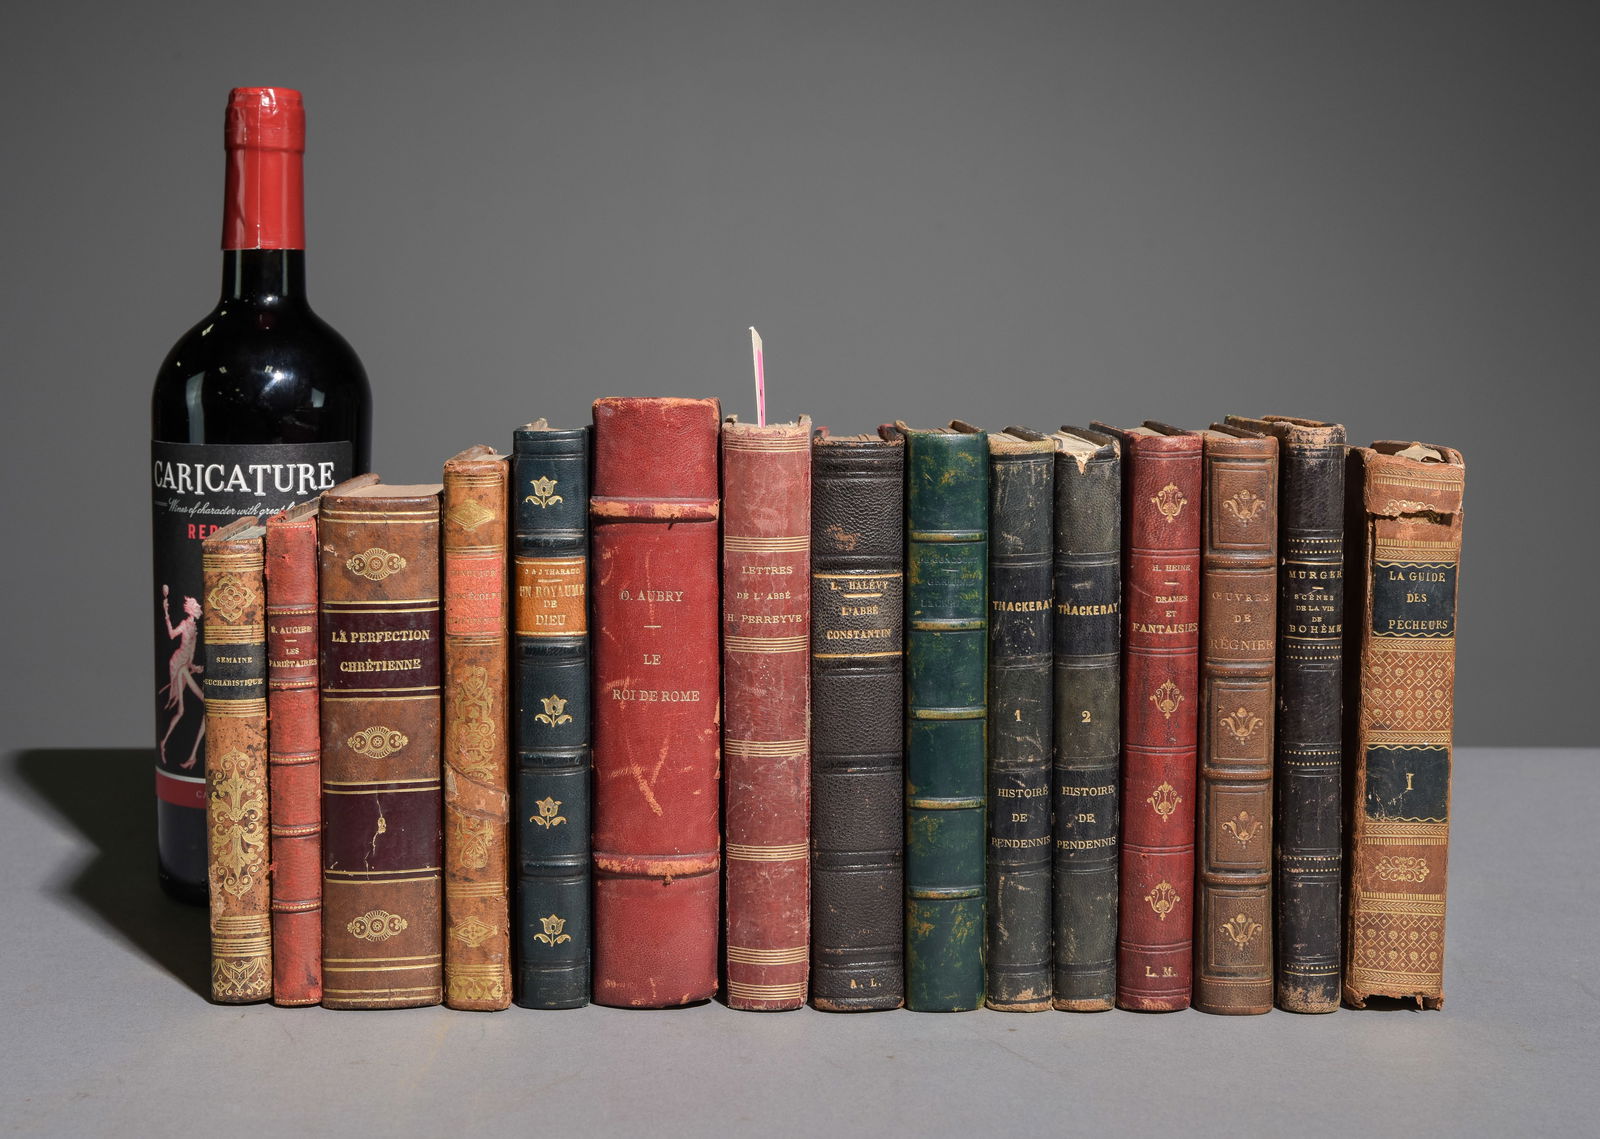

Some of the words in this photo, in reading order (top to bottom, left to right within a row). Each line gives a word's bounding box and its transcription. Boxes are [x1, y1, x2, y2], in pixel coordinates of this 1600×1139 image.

[154, 460, 335, 496] CARICATURE
[197, 501, 236, 515] character
[236, 502, 259, 516] with
[742, 566, 793, 575] LETTRES
[1152, 564, 1163, 572] H.
[1165, 564, 1191, 572] HEINE
[1289, 570, 1342, 579] MURGER
[1389, 571, 1405, 581] LA
[1409, 572, 1446, 582] GUIDE
[830, 581, 842, 591] L.
[848, 580, 888, 590] HALÉVY
[620, 590, 633, 601] O.
[637, 591, 684, 602] AUBRY
[737, 591, 750, 600] DE
[1155, 595, 1188, 603] DRAMES
[1406, 593, 1427, 603] DES
[543, 600, 558, 608] DE
[1057, 602, 1118, 616] THACKERAY
[841, 605, 879, 616] L'ABBÉ
[1165, 610, 1177, 618] ET
[535, 614, 566, 626] DIEU
[727, 613, 738, 622] H.
[741, 614, 803, 624] PERREYVE
[1234, 615, 1251, 623] DE
[279, 625, 312, 635] AUGIER
[1132, 622, 1198, 634] FANTAISIES
[1289, 623, 1342, 634] BOHÈME
[351, 629, 431, 643] PERFECTION
[826, 628, 892, 640] CONSTANTIN
[1209, 637, 1274, 651] RÉGNIER
[286, 647, 300, 655] LES
[215, 656, 253, 664] SEMAINE
[643, 653, 661, 665] LE
[204, 677, 264, 687] EUCHARISTIQUE
[613, 689, 636, 701] ROI
[639, 691, 658, 702] DE
[661, 690, 700, 702] ROME
[1014, 709, 1022, 722] 1
[1081, 710, 1091, 723] 2
[997, 785, 1049, 799] HISTOIRE
[1062, 784, 1117, 797] HISTOIRE
[1012, 813, 1028, 823] DE
[1078, 813, 1096, 823] DE
[992, 835, 1051, 849] PENDENNIS
[1057, 835, 1118, 850] PENDENNIS
[1145, 965, 1159, 978] L.
[1161, 966, 1178, 978] M.
[850, 978, 864, 990] A.
[870, 977, 882, 988] L.
